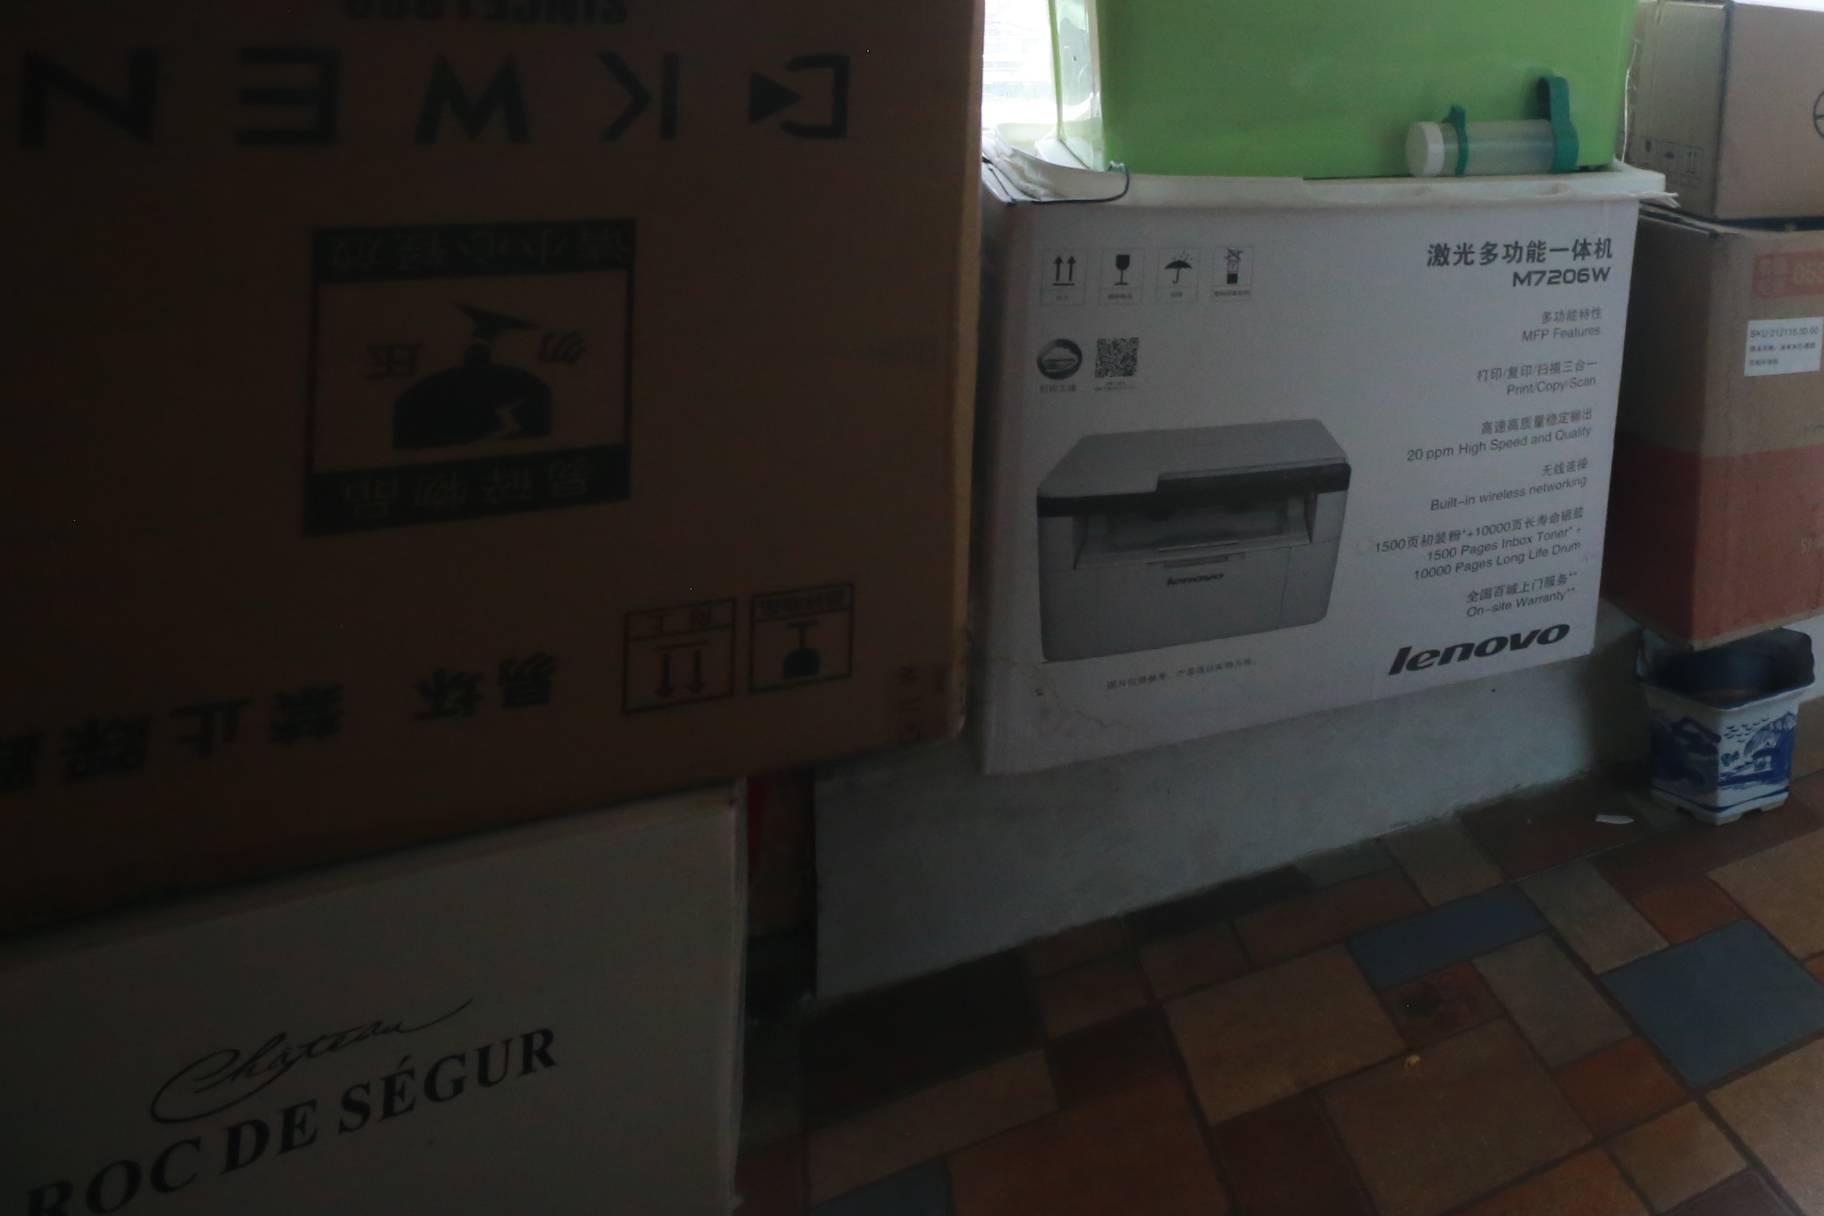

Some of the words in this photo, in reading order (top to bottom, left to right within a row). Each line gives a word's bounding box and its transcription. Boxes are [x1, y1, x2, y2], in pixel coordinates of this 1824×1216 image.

[1426, 237, 1613, 268] 激光多功能一体机
[1512, 266, 1612, 288] M7206W
[1541, 306, 1603, 325] 多功能特性
[1521, 328, 1550, 343] MFP
[1552, 324, 1601, 340] Features
[1476, 358, 1599, 385] 打印/复印/扫描三合一
[1506, 376, 1597, 397] Print/Copy/Scan
[1407, 448, 1424, 464] 20
[1425, 446, 1455, 462] ppm
[1457, 436, 1487, 457] High
[1489, 432, 1528, 453] Speed
[1530, 431, 1552, 446] and
[1554, 424, 1593, 442] Quality
[1479, 487, 1527, 504] wireless
[1528, 476, 1589, 496] networking
[1414, 564, 1451, 581] 10000
[1455, 559, 1494, 576] Pages
[1495, 551, 1527, 569] Long
[1528, 546, 1549, 560] Life
[1551, 540, 1582, 556] Drum
[1426, 547, 1458, 563] 1500
[1460, 541, 1499, 558] Pages
[1501, 534, 1534, 550] Inbox
[1166, 572, 1225, 586] lenovo
[1388, 623, 1571, 676] lenovo
[25, 1136, 202, 1216] ROC
[219, 1098, 319, 1177] DE
[336, 1025, 560, 1136] SÉGUR
